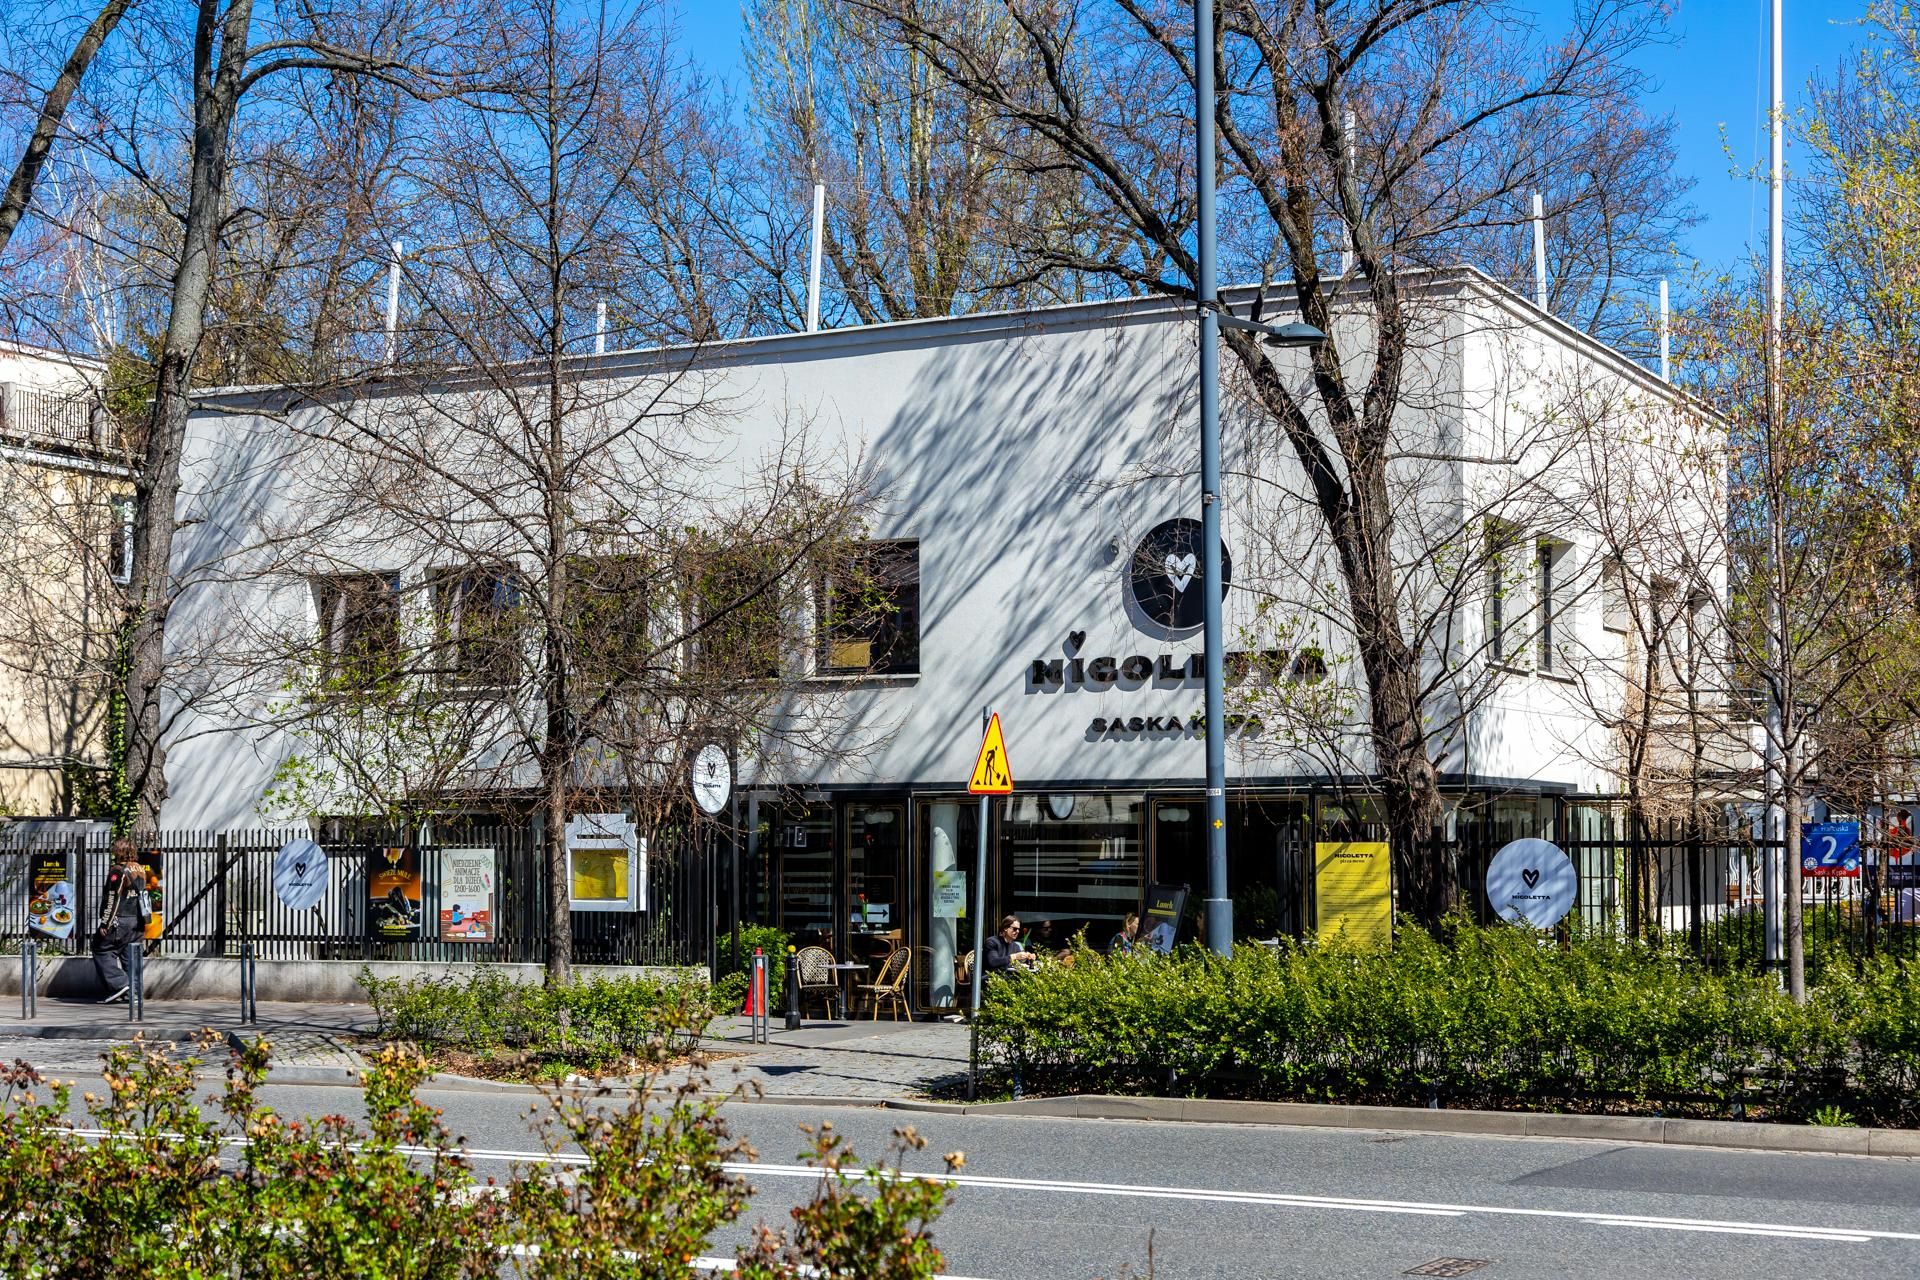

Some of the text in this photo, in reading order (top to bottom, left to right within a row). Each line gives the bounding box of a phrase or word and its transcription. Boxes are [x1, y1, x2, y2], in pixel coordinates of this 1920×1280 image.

[1091, 713, 1265, 733] SASKA KPA
[1334, 851, 1374, 859] NICOLETTA
[1821, 836, 1838, 864] 2
[1156, 900, 1174, 910] Lunch
